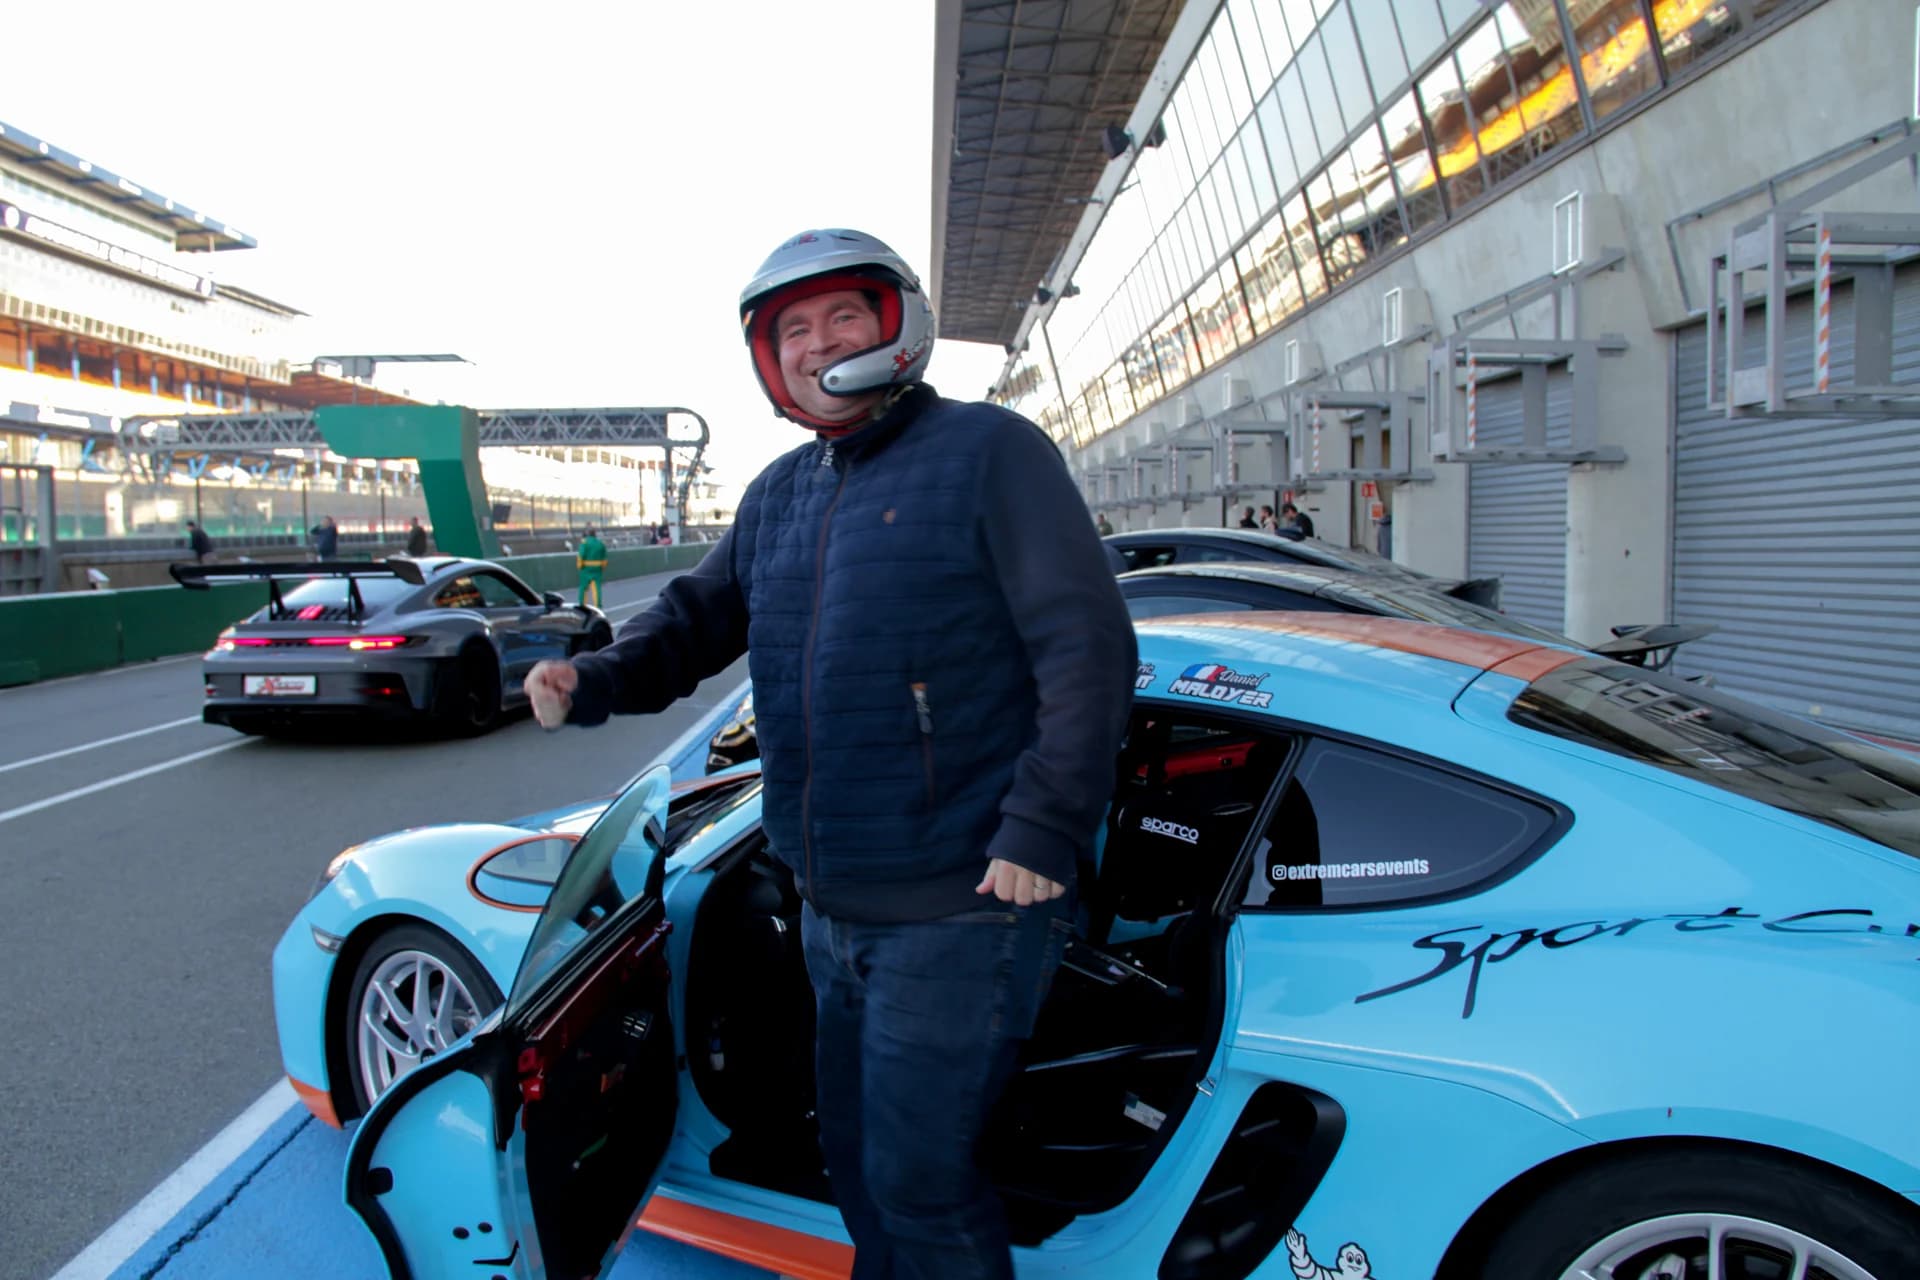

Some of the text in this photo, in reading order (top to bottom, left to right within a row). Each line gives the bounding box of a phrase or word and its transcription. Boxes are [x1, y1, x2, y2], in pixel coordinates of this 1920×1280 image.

[1218, 669, 1270, 687] Daniel
[1141, 816, 1199, 841] sparco
[1288, 858, 1430, 881] extremcarsevents
[1354, 896, 1760, 1020] Sport
